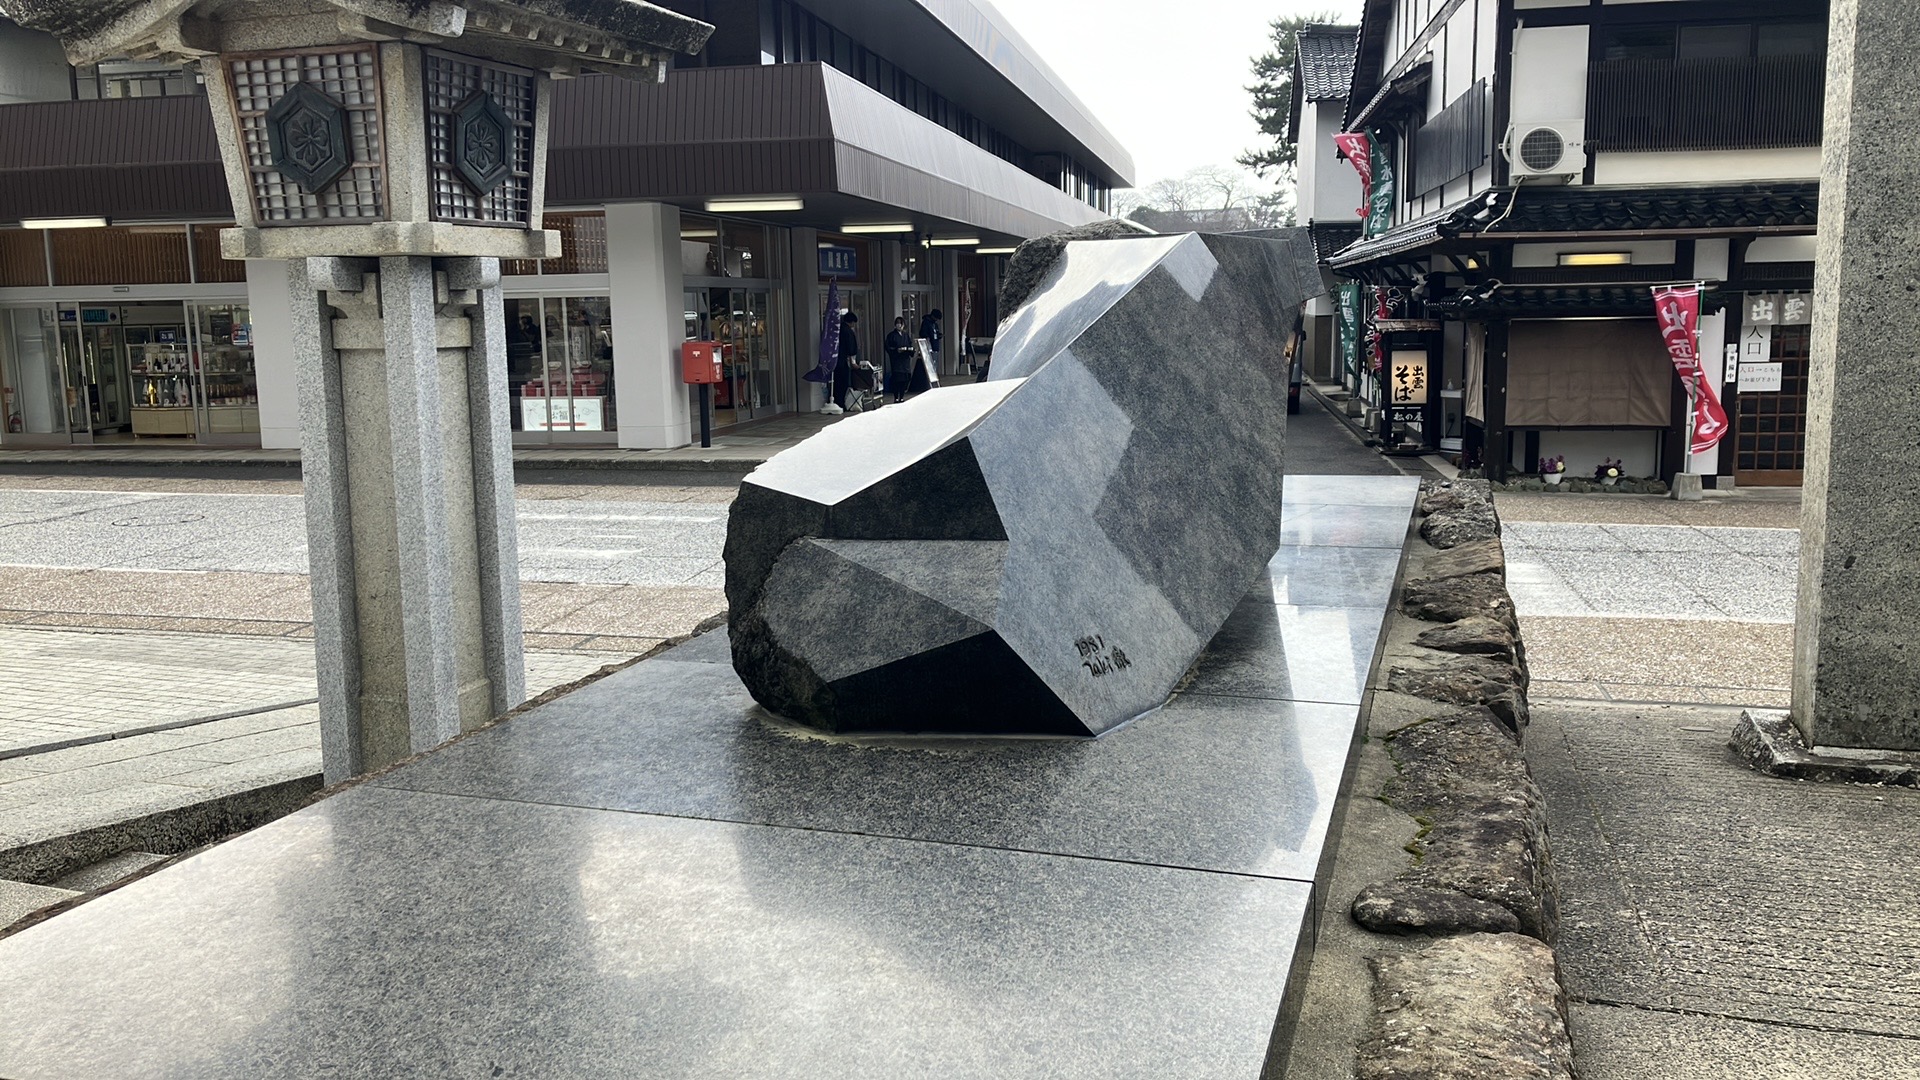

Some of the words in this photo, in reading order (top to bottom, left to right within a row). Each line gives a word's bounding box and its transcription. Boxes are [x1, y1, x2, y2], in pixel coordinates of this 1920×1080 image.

[1751, 298, 1805, 321] 出雲
[1747, 325, 1763, 355] 入口
[1395, 364, 1415, 401] そば
[1412, 365, 1424, 389] 出雲
